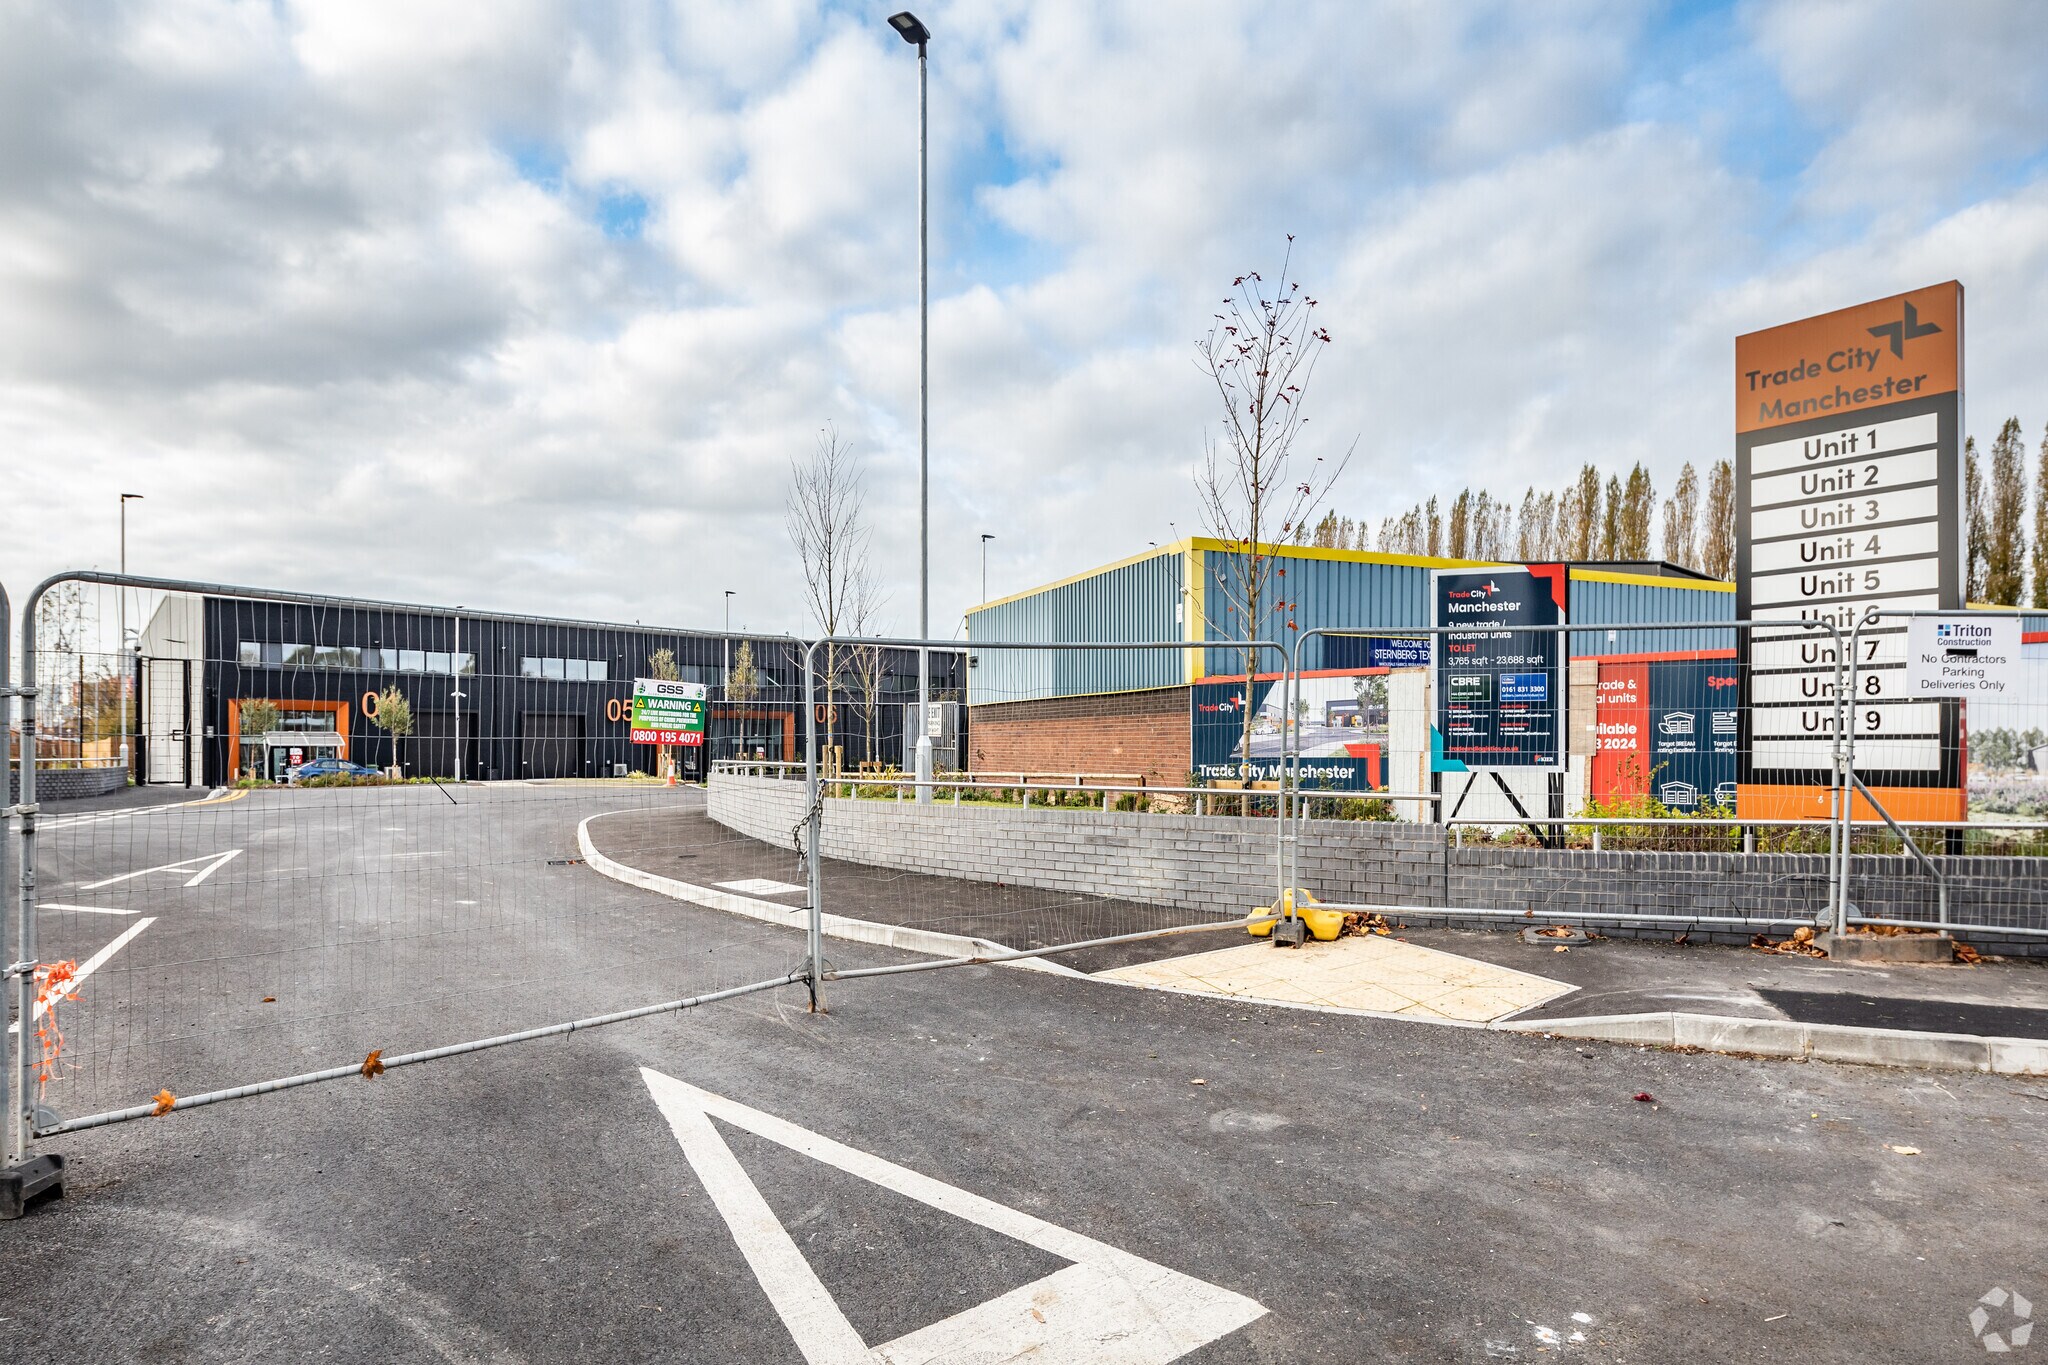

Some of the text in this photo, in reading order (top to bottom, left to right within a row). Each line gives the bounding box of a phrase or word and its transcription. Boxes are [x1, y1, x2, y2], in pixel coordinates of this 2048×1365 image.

[1745, 347, 1881, 391] Trade City
[1759, 374, 1927, 423] Manchester
[1804, 429, 1876, 460] Unit 1
[1801, 465, 1879, 495] Unit 2
[1801, 500, 1879, 529] Unit 3
[1800, 535, 1881, 562] Unit 4
[1801, 570, 1880, 596] Unit 5
[1448, 601, 1521, 613] Manchester
[1801, 605, 1880, 630] Unit 6
[1448, 631, 1512, 640] industrial units
[1953, 624, 1991, 637] Triton
[1391, 640, 1422, 648] WELCOME
[1462, 644, 1476, 652] LET
[1937, 638, 1992, 646] Construction
[1375, 649, 1417, 660] STERNBERG
[1801, 640, 1881, 664] Unt 7
[1448, 657, 1469, 666] 3,765
[1472, 656, 1488, 666] sqft
[1496, 655, 1524, 666] 23,688
[1527, 655, 1543, 666] sqft
[1921, 654, 2007, 664] No Contractors
[1942, 667, 1985, 679] Parking
[1451, 677, 1480, 686] CBRE
[1597, 679, 1637, 690] rade &
[1801, 675, 1881, 697] Un 8
[1921, 679, 2005, 692] Deliveries Only
[657, 684, 684, 695] GSS
[1609, 693, 1637, 703] units
[607, 699, 632, 722] 05
[647, 699, 692, 711] WARNING
[1802, 710, 1881, 731] Uni 9
[1597, 723, 1637, 734] ilable
[633, 731, 701, 743] 0800 195 4071
[1604, 738, 1637, 749] 2024
[1199, 764, 1236, 777] Trade
